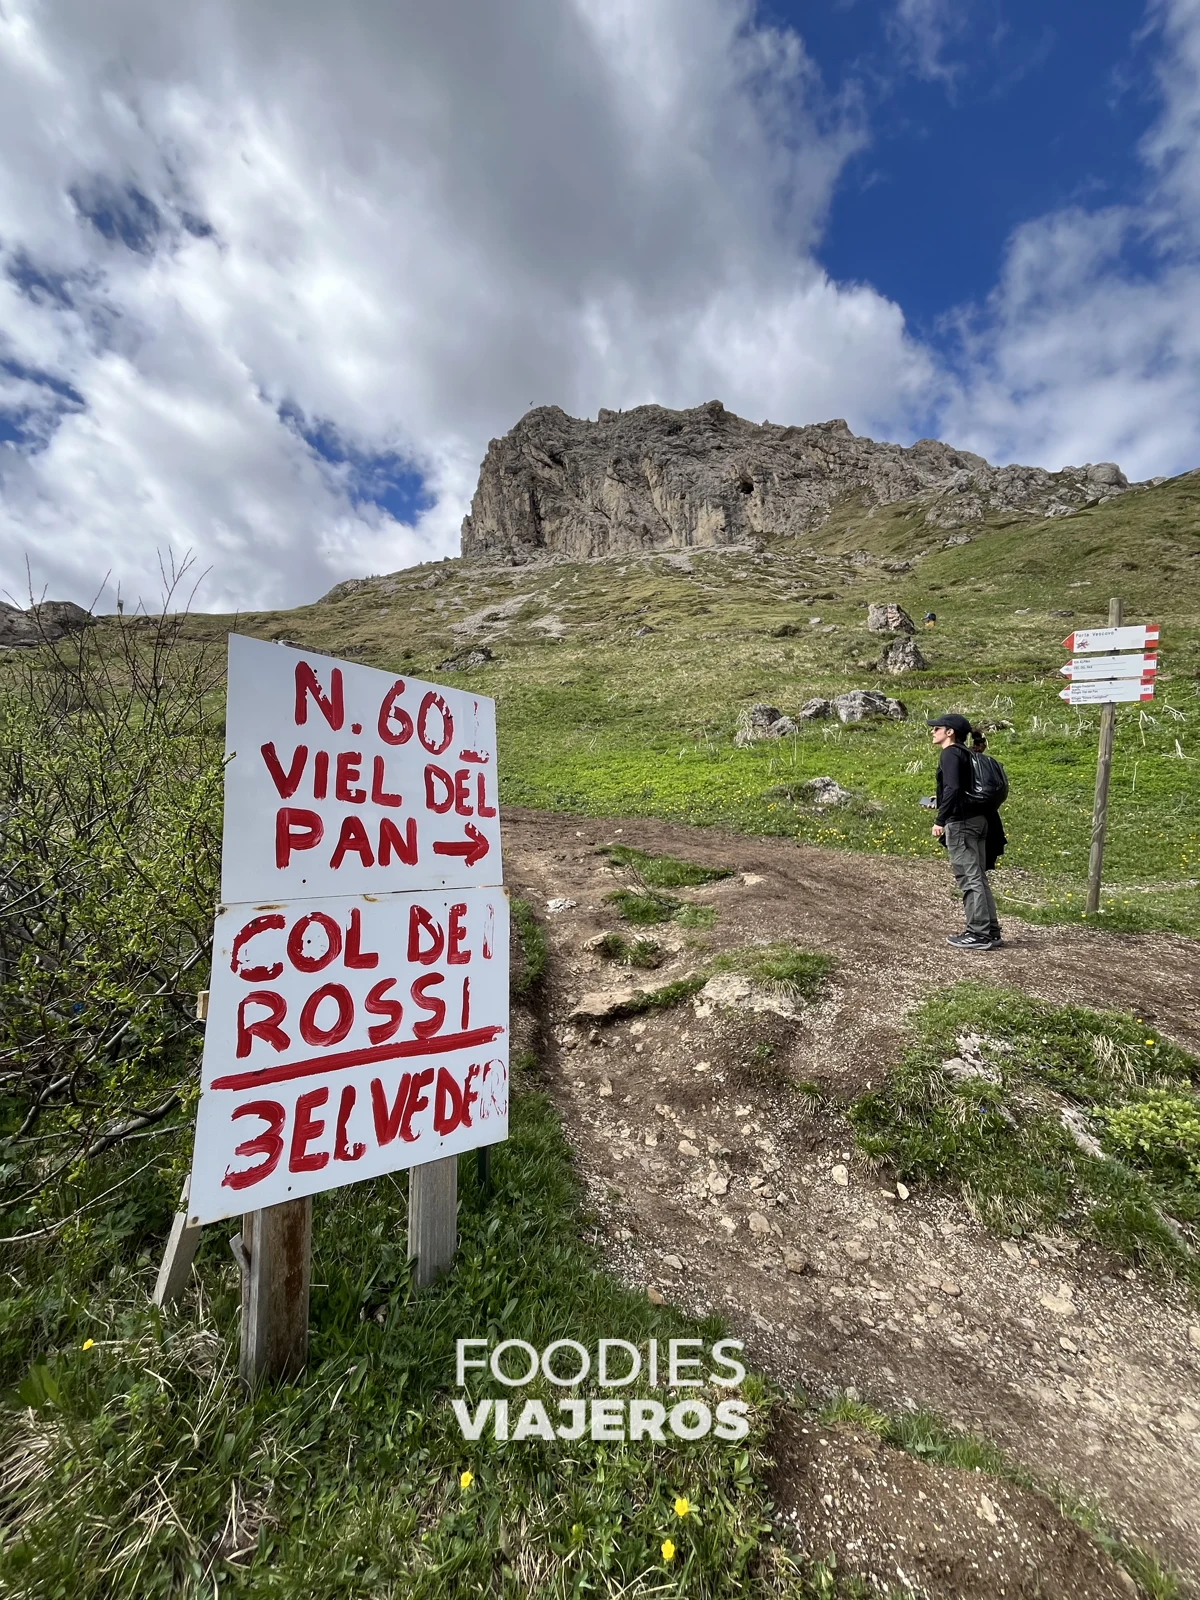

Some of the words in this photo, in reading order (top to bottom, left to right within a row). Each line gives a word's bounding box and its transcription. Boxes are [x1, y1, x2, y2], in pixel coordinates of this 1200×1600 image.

[261, 743, 402, 808] VIEL
[424, 763, 498, 818] DEL
[275, 807, 419, 869] PAN
[230, 908, 380, 983] COL
[407, 902, 495, 967] DEI
[236, 972, 472, 1060] ROSSI
